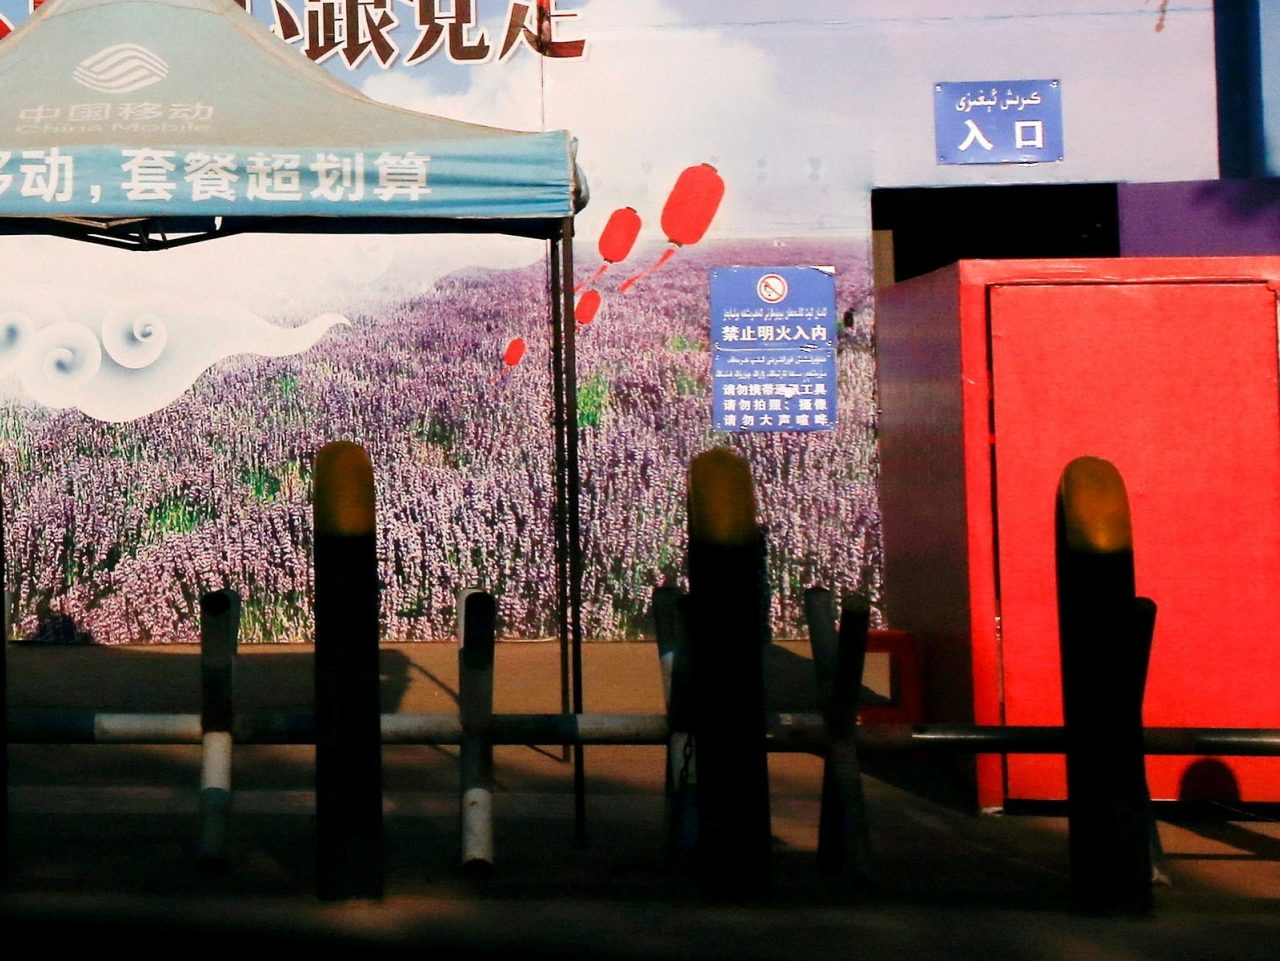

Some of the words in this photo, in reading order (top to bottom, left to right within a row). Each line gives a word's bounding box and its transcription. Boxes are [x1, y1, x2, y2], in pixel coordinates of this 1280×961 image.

[19, 102, 214, 122] 中国移动
[16, 123, 102, 134] China
[112, 121, 211, 133] Mobile
[957, 119, 1044, 152] 入口
[722, 324, 827, 341] 禁止明火入内
[723, 414, 828, 427] 请勿大声喧哗
